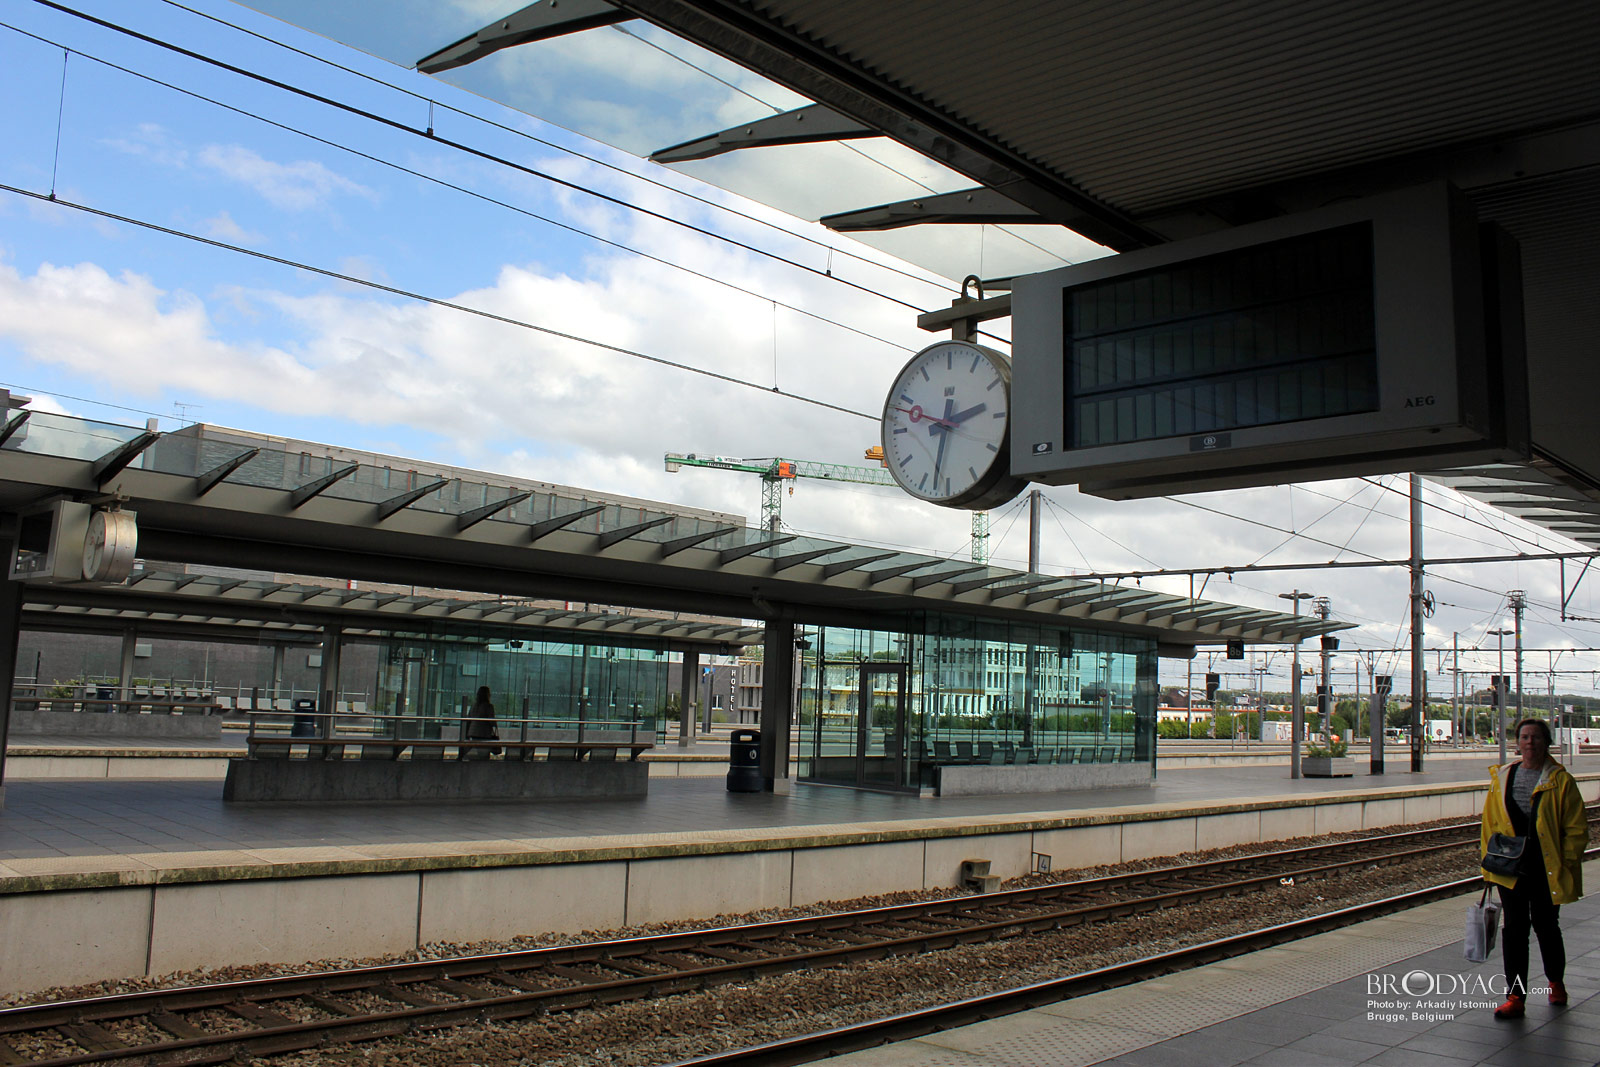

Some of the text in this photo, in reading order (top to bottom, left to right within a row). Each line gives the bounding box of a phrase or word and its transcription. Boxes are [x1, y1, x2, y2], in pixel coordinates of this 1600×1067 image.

[1403, 395, 1436, 409] AEG
[1229, 646, 1242, 657] 8b
[1040, 858, 1048, 871] 4
